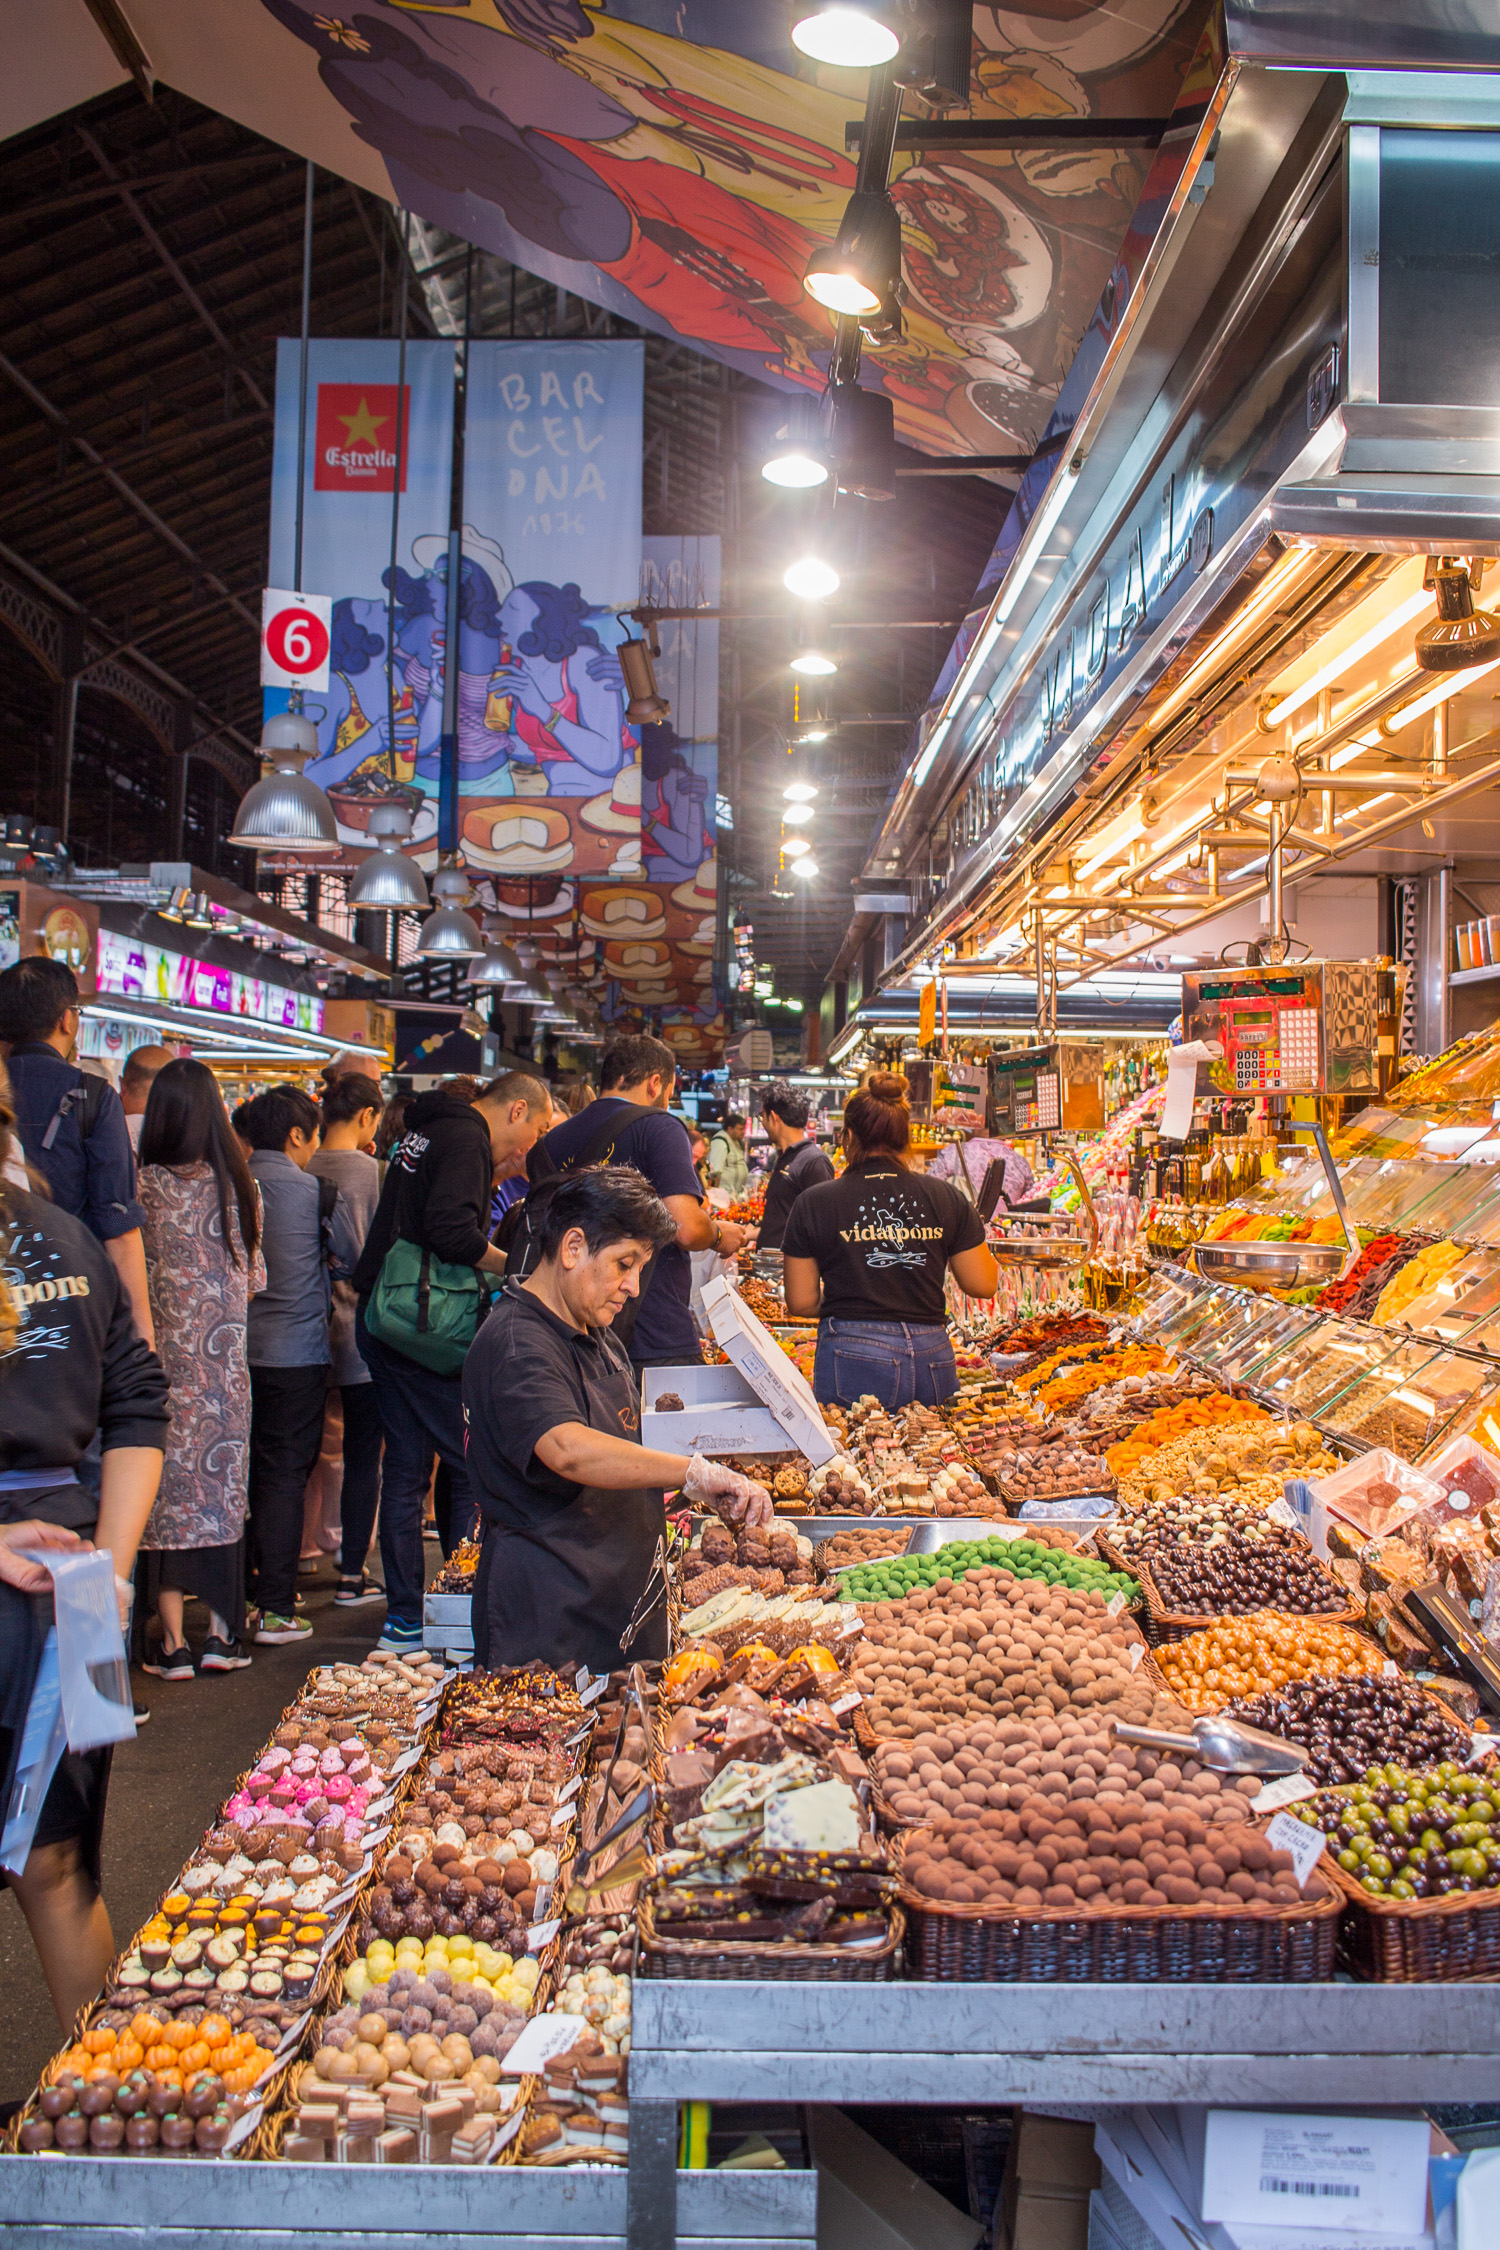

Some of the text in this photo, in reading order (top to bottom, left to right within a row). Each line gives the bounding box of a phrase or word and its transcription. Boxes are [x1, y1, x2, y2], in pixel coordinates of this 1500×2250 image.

[499, 370, 605, 412] BAR
[325, 447, 397, 467] Estrella
[507, 416, 605, 459] CEL
[283, 618, 312, 665] 6
